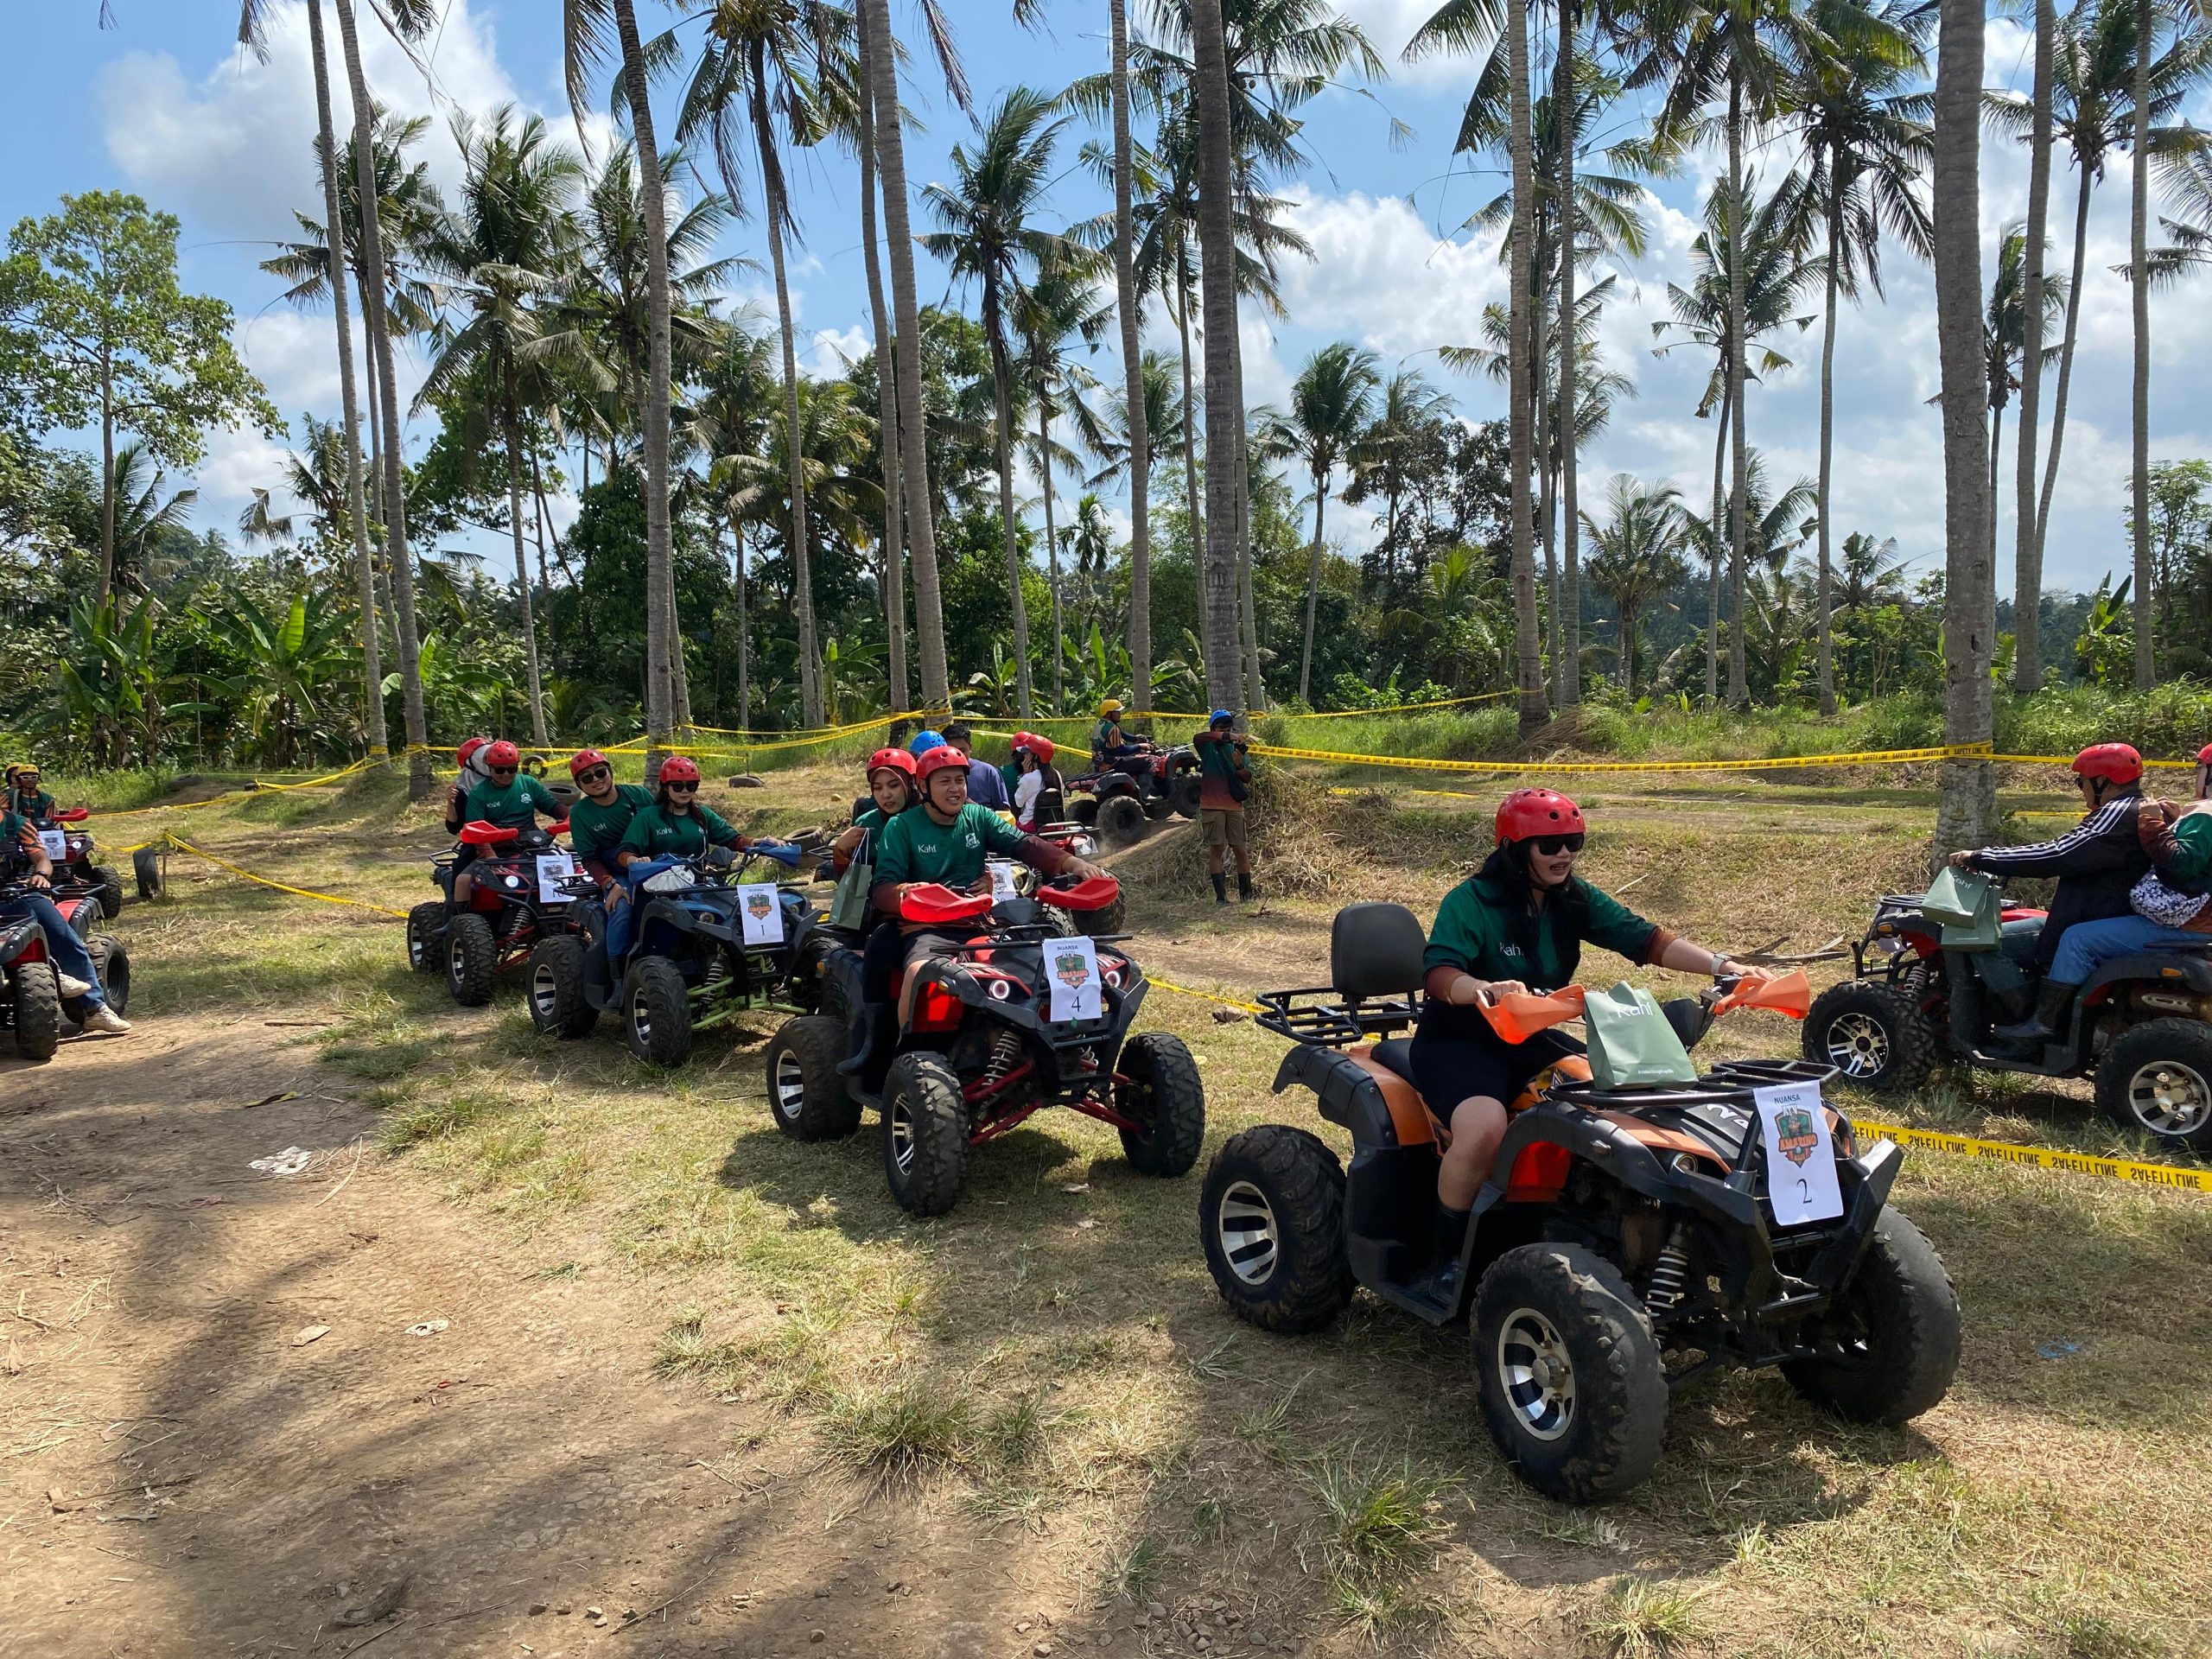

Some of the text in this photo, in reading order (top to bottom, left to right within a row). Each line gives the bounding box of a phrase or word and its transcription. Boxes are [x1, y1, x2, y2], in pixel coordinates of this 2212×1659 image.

[1955, 747, 1972, 755] SAFETY
[1973, 747, 1982, 755] LINE
[656, 827, 672, 836] Kahf
[918, 843, 937, 854] Kahf
[760, 925, 765, 936] 1
[1071, 995, 1081, 1012] 4
[1617, 1001, 1653, 1018] Kahf
[1774, 1094, 1801, 1104] NUANSA
[1796, 1178, 1813, 1205] 2
